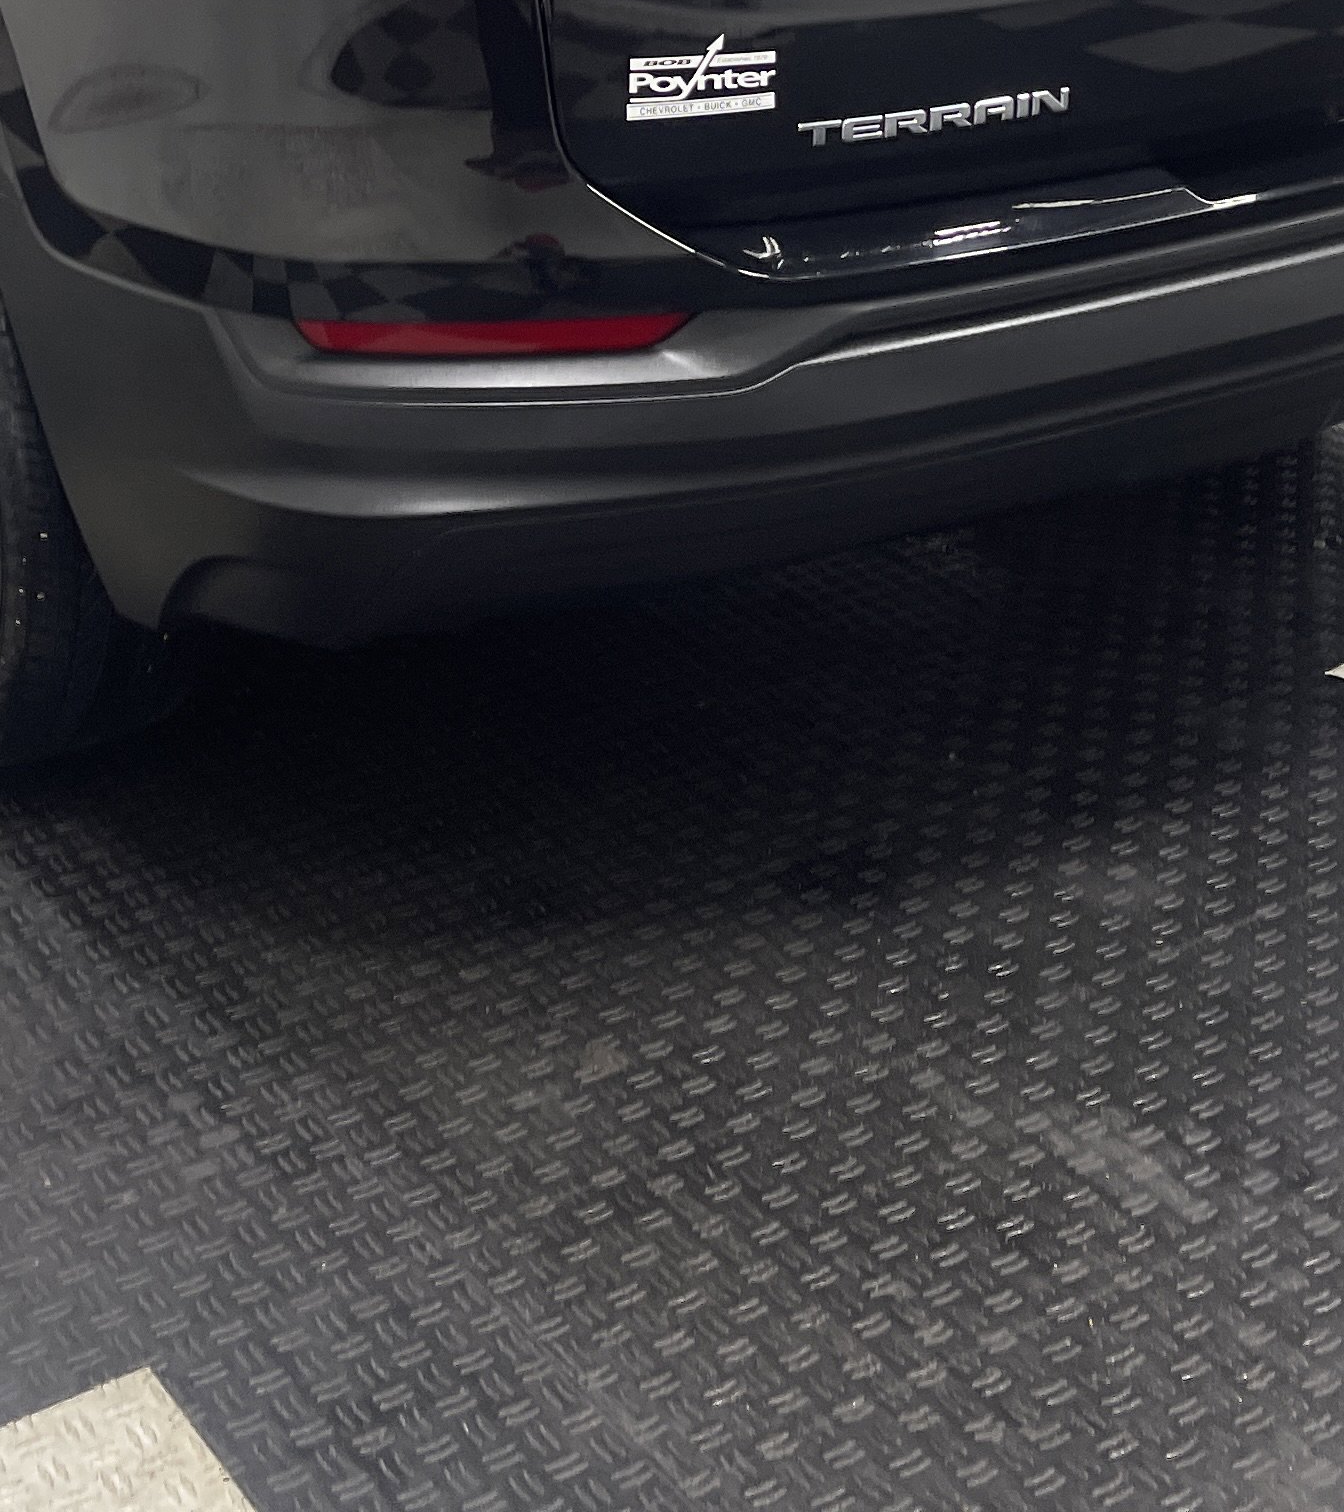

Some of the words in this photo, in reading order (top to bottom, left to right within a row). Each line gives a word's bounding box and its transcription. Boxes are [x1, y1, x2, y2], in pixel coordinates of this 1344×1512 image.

[643, 58, 691, 67] BOB
[628, 69, 776, 100] Poynter
[639, 103, 694, 116] CHEVROLET
[704, 100, 732, 111] BUICK
[741, 97, 762, 107] GMC
[797, 87, 1070, 147] TERRAIN
